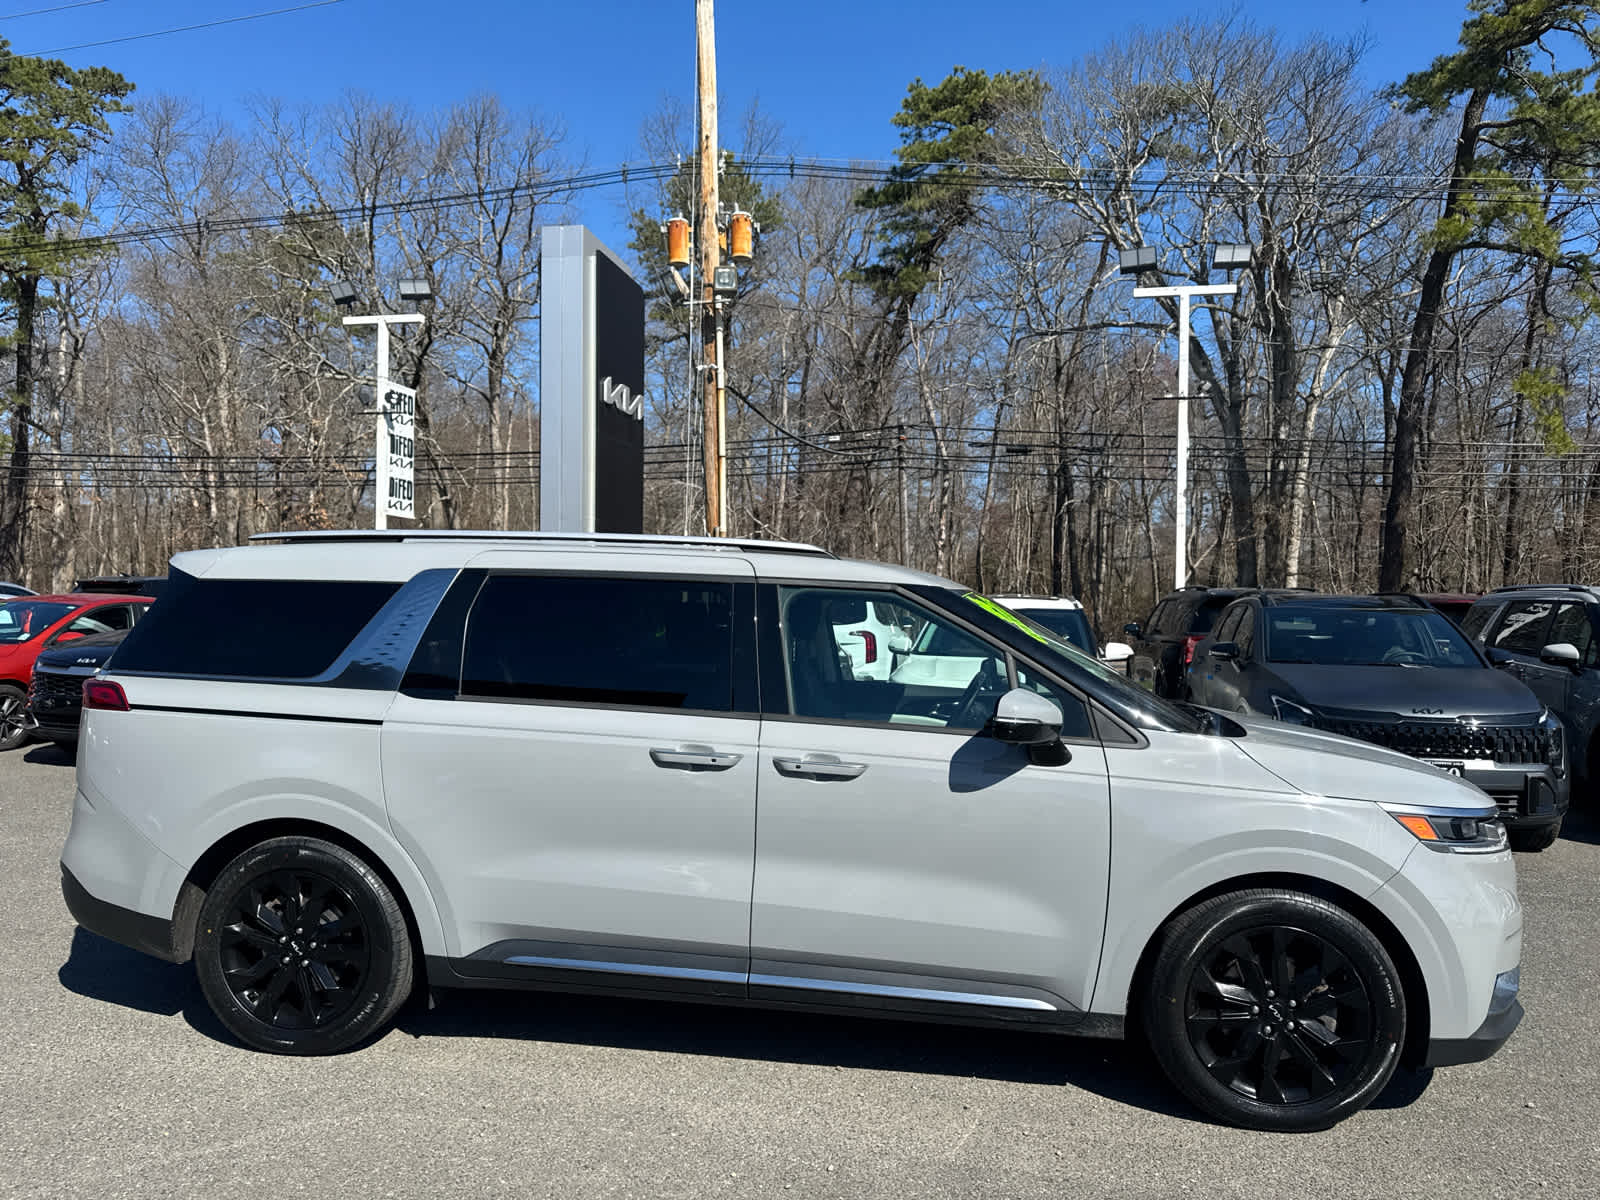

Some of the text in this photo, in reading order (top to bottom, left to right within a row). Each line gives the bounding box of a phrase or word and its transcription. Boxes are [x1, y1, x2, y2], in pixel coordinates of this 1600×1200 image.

[603, 376, 644, 420] KIA
[390, 456, 413, 469] KIA
[388, 500, 412, 512] KIA
